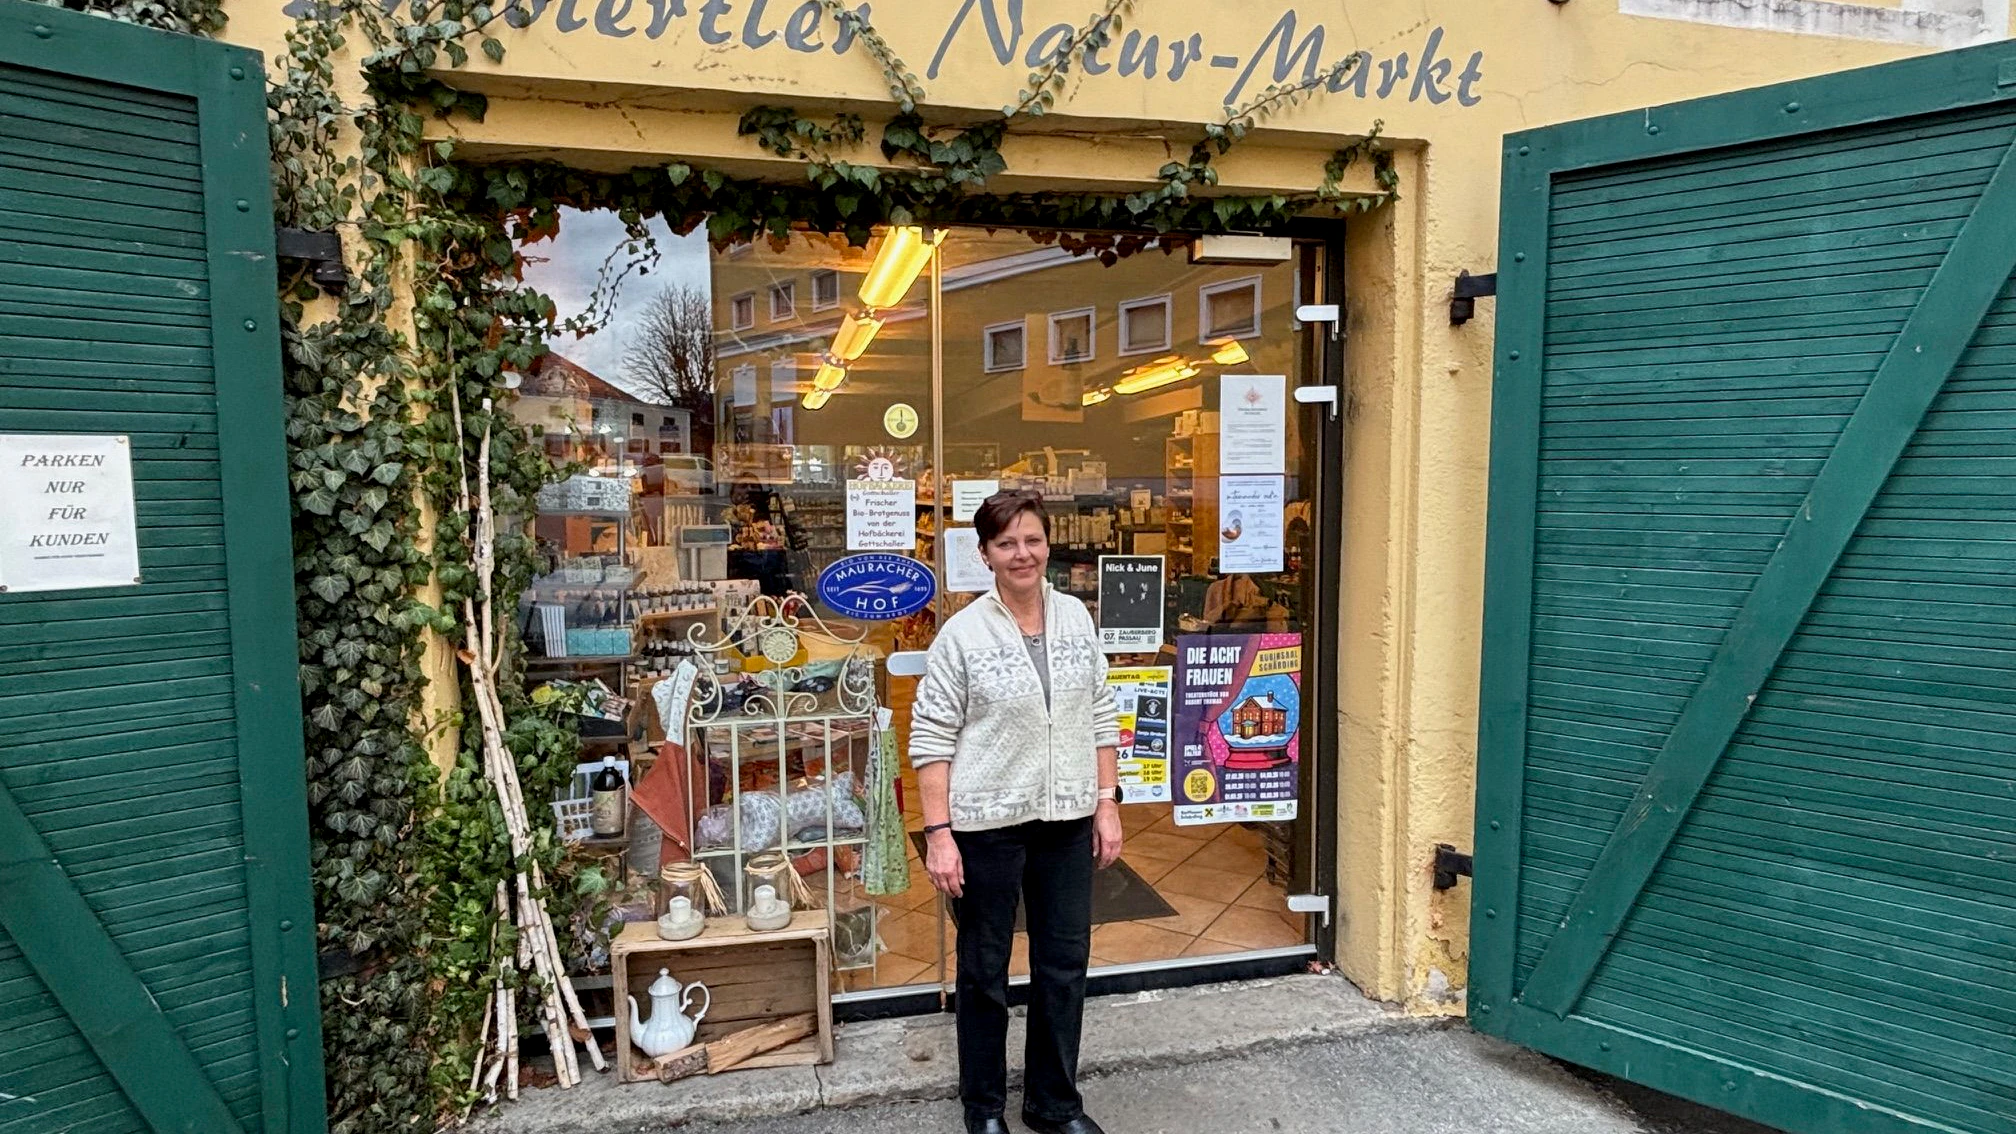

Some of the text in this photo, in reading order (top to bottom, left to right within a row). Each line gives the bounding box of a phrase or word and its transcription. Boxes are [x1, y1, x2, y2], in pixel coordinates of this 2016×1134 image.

[926, 0, 1485, 108] Natur-Markt
[20, 454, 106, 467] PARKEN
[44, 481, 86, 494] NUR
[865, 499, 898, 507] Frischer
[48, 504, 87, 520] FÜR
[852, 509, 910, 518] Bio-Brotgenuss
[29, 532, 110, 548] KUNDEN
[835, 563, 920, 582] MAURACHER
[1105, 563, 1158, 572] Nick & June
[856, 596, 899, 610] HOF
[1186, 646, 1241, 665] DIE ACHT
[1186, 668, 1233, 686] FRAUEN
